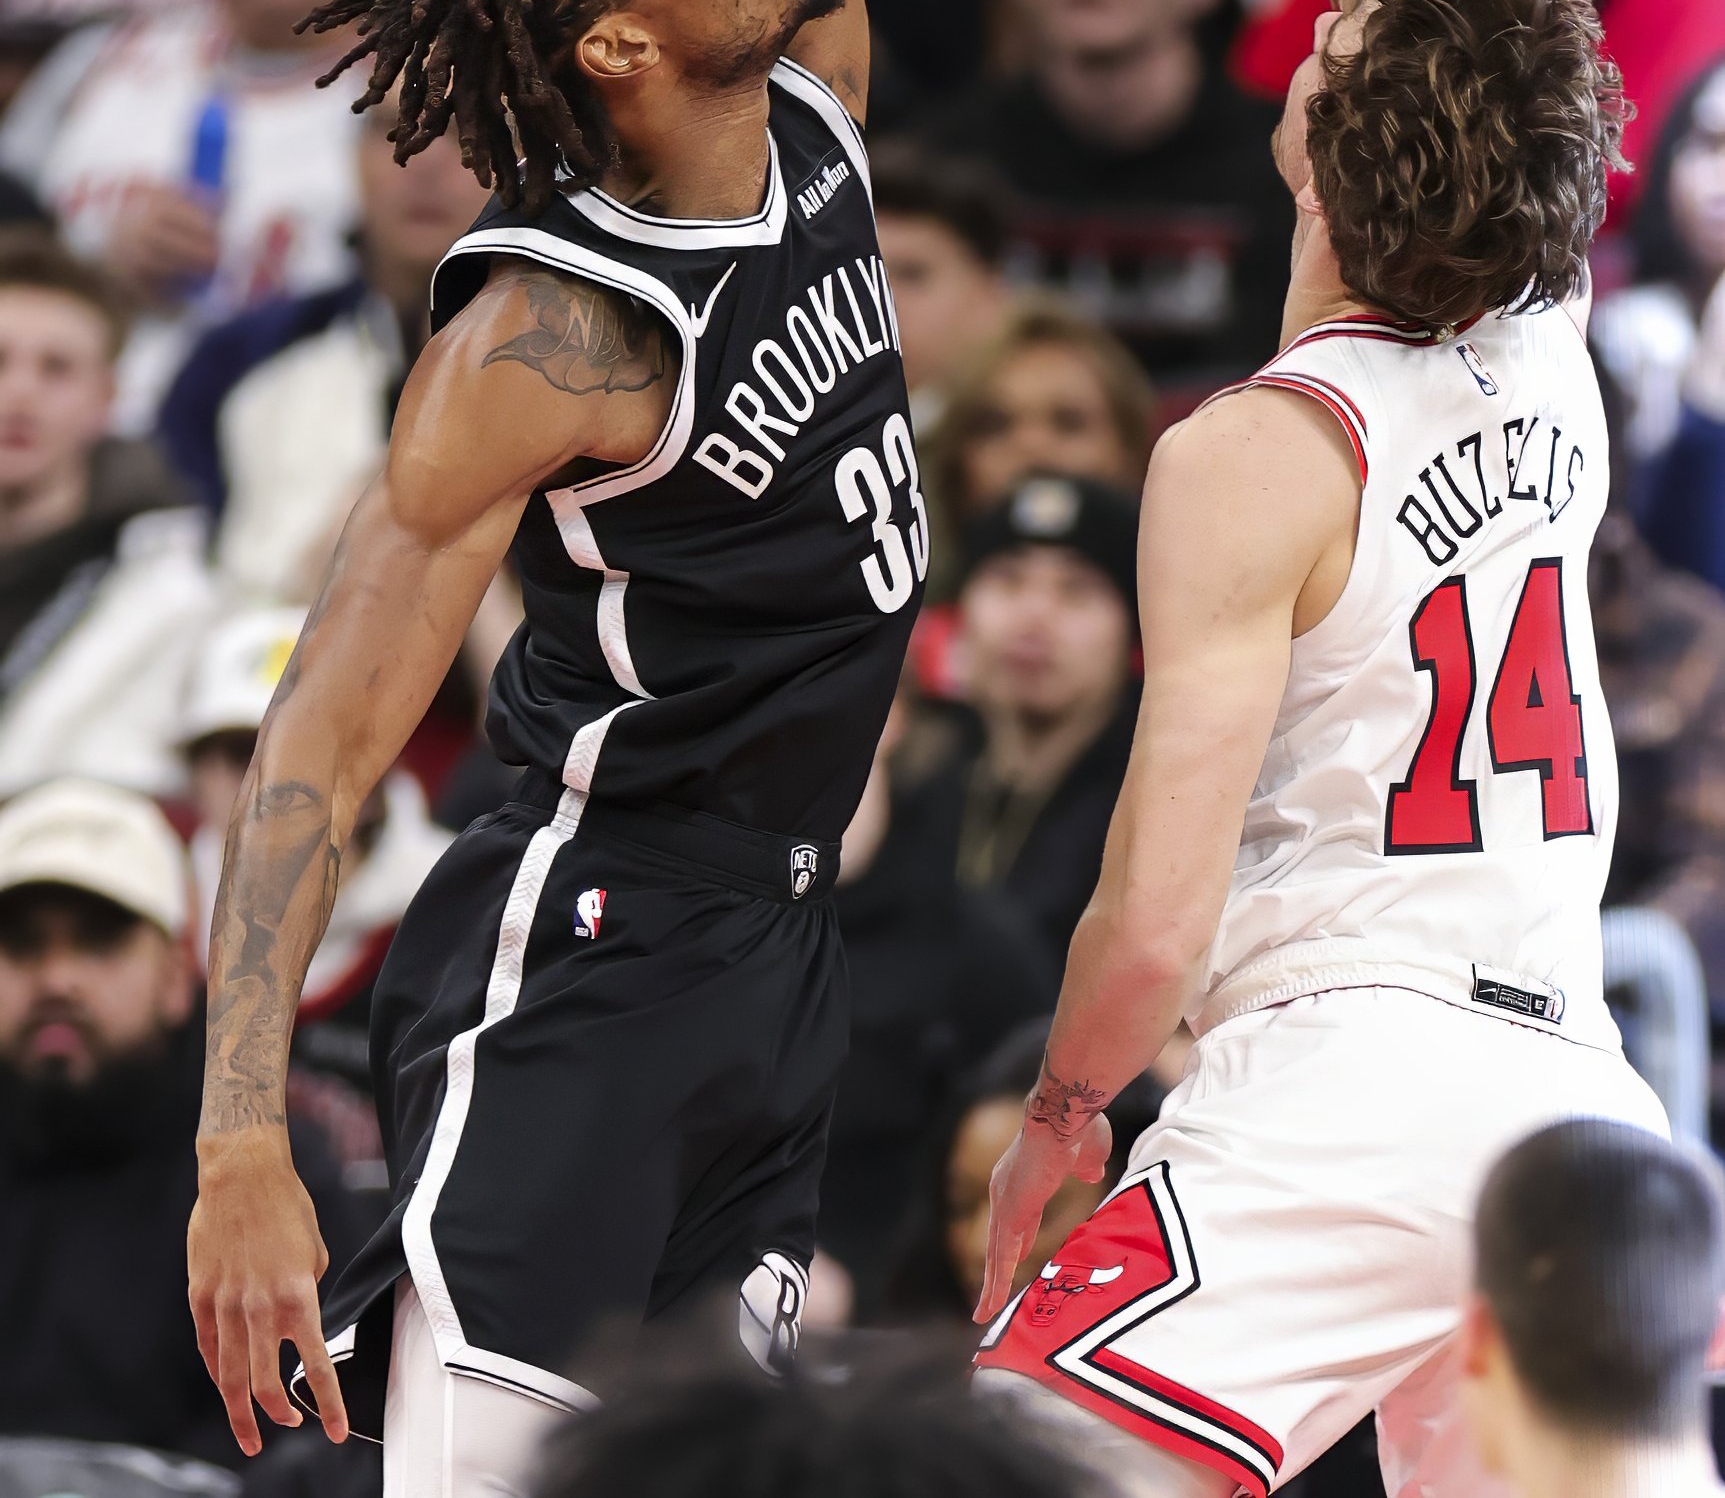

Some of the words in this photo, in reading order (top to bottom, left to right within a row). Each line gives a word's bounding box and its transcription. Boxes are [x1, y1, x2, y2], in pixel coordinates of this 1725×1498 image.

[692, 255, 903, 501] BROOKLYN
[834, 412, 931, 614] 33
[1384, 556, 1595, 856] 14
